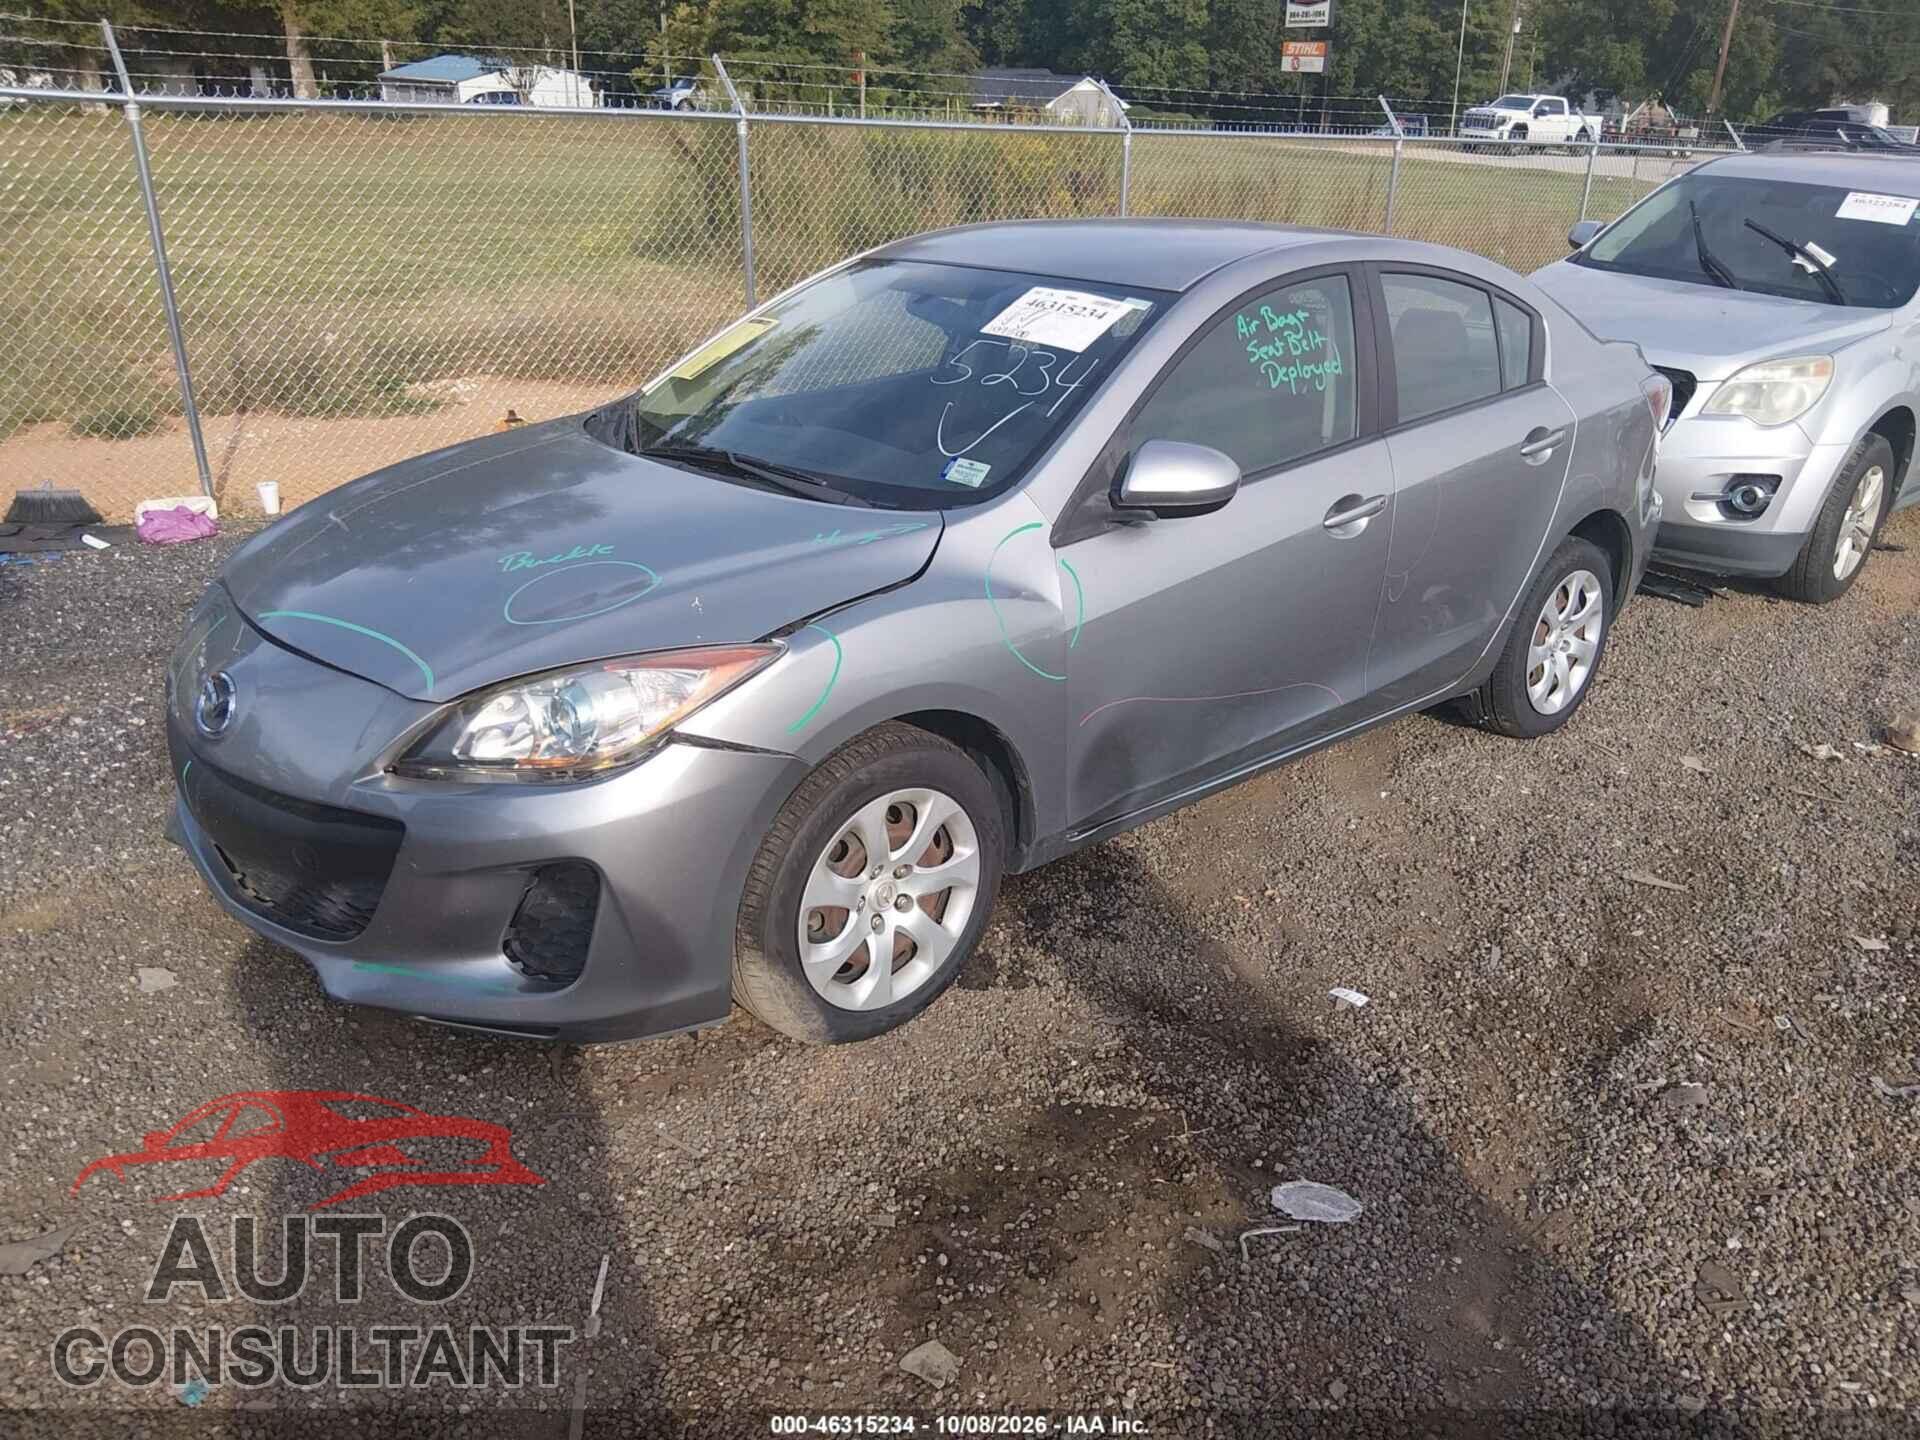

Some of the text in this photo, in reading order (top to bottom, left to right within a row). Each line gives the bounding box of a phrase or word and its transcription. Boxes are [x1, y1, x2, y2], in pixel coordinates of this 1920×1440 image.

[1026, 299, 1109, 320] 46315234
[1237, 314, 1260, 340] Air
[1246, 330, 1329, 362] Seat Belt
[930, 340, 1100, 417] 5234
[1260, 346, 1343, 395] Deployed
